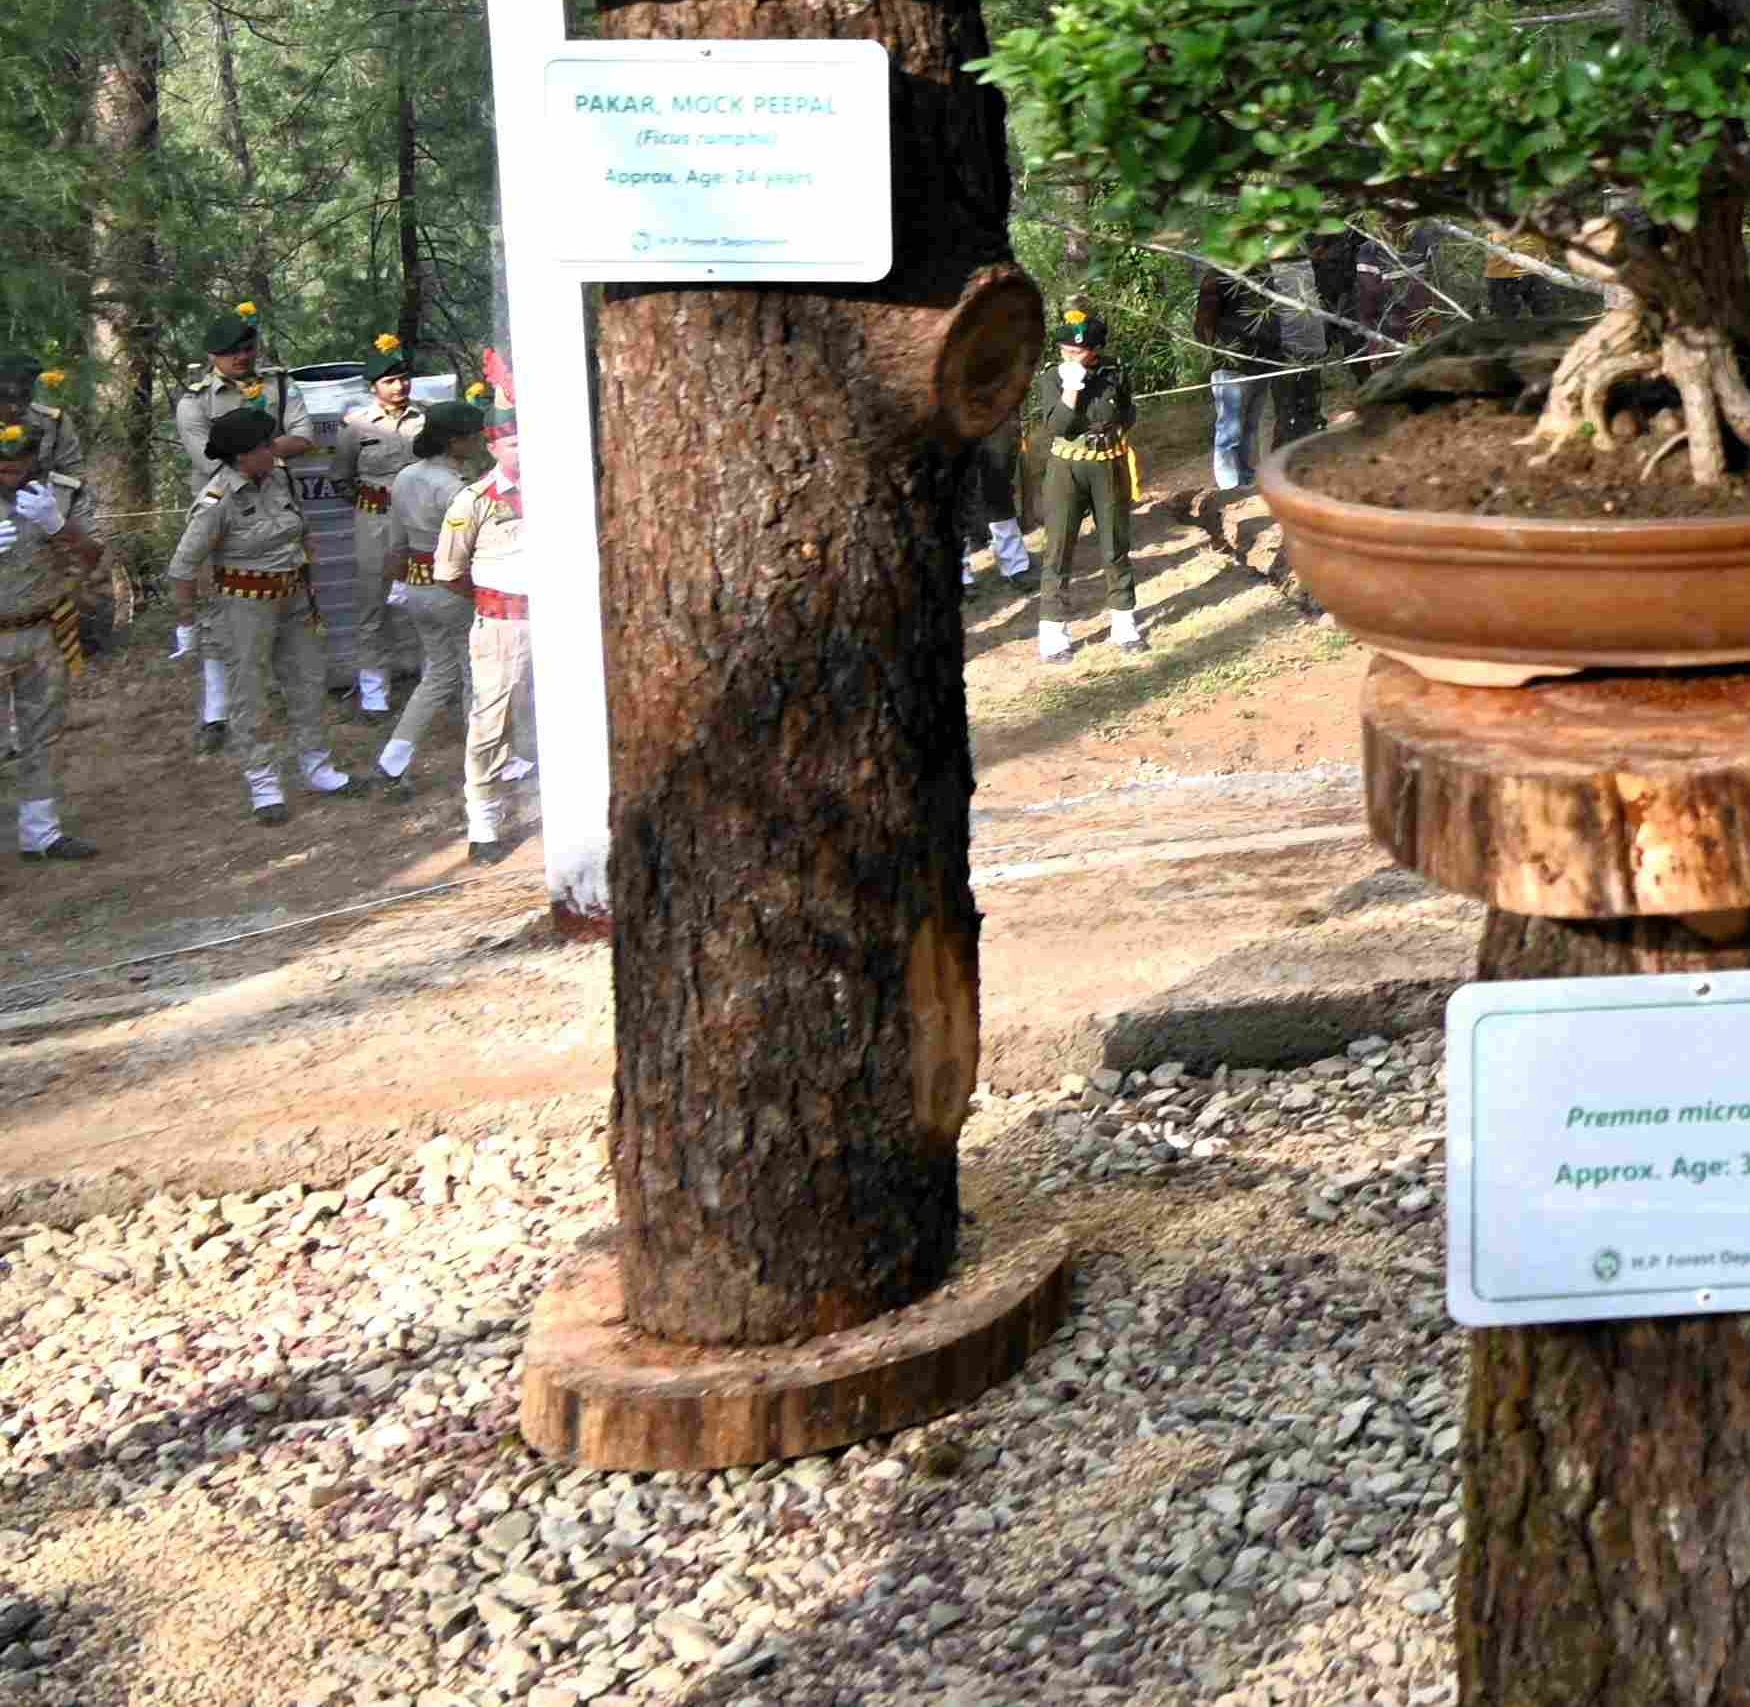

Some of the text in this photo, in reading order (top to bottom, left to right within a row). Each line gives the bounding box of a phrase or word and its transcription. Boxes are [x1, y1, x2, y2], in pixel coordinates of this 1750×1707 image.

[574, 94, 837, 115] PAKAR, MOCK PEEPAL
[1566, 1105, 1670, 1129] Premna
[1554, 1162, 1662, 1190] Approx.
[1671, 1156, 1730, 1184] Age:
